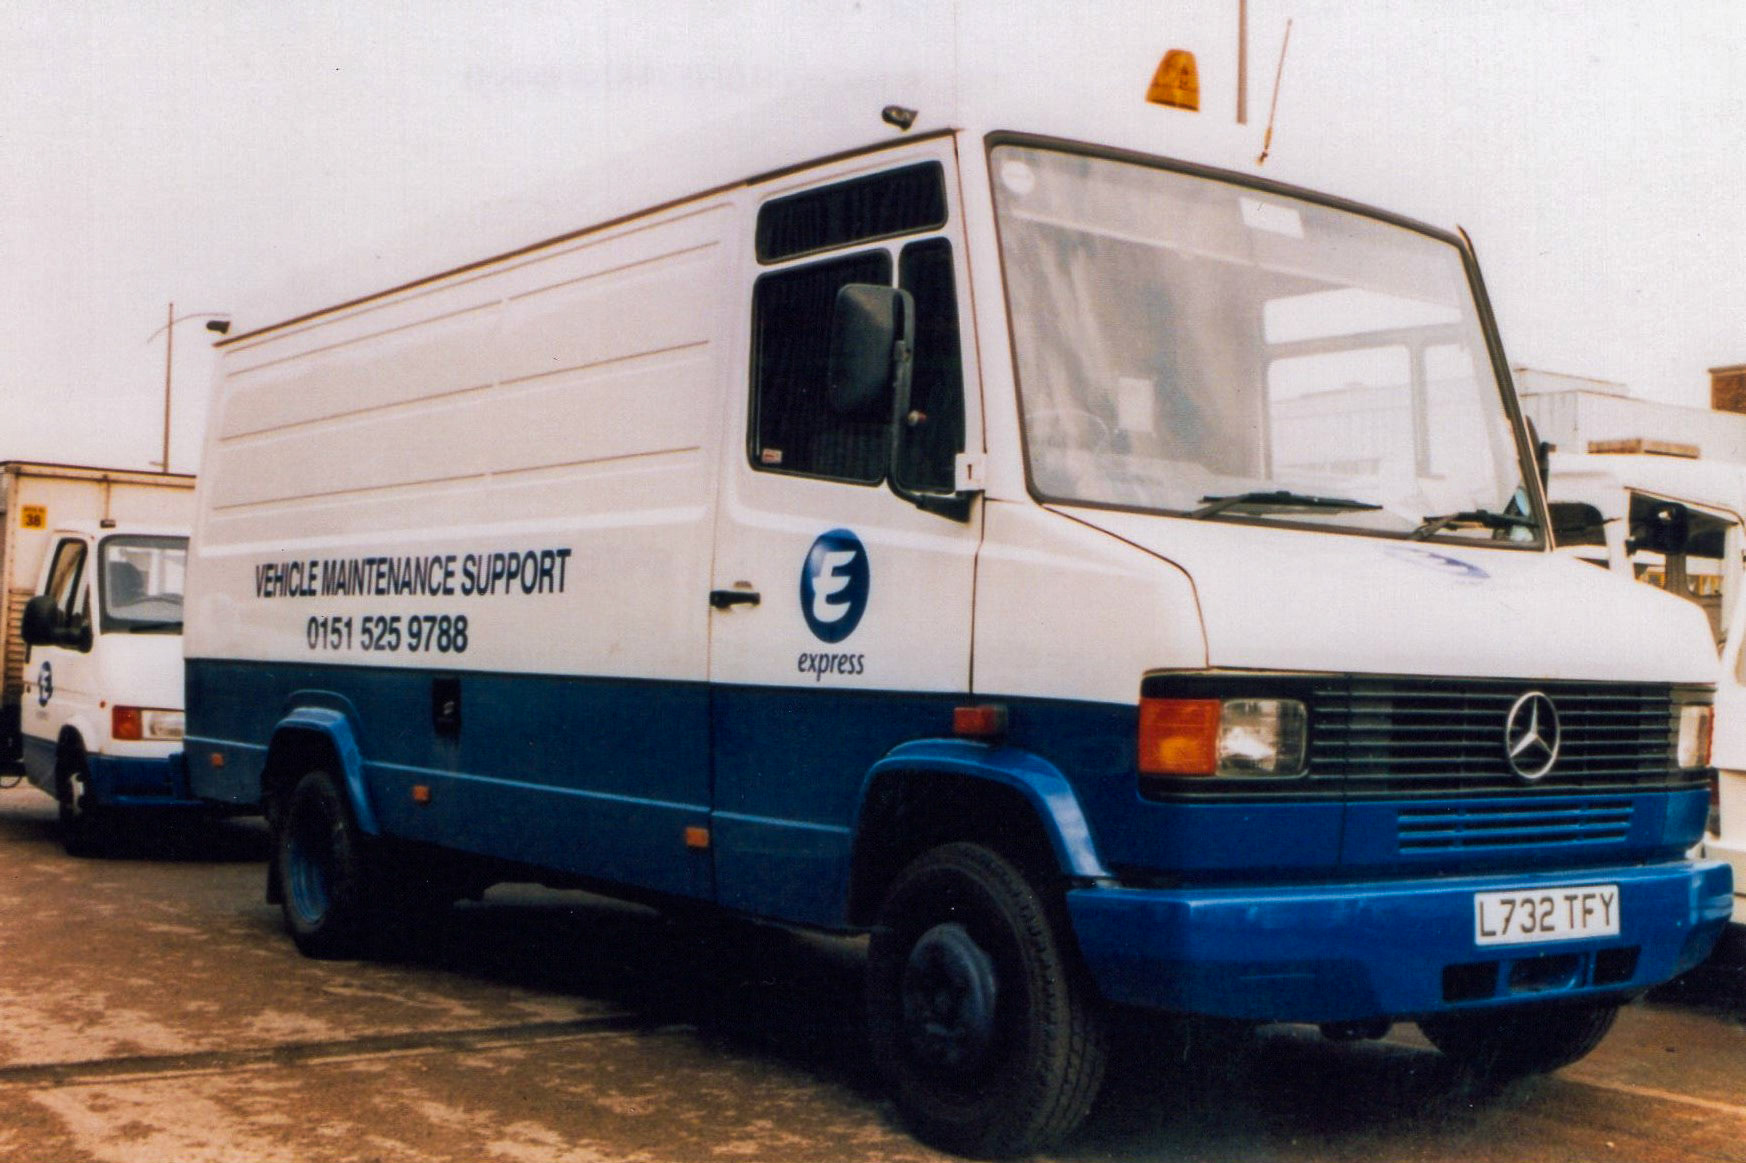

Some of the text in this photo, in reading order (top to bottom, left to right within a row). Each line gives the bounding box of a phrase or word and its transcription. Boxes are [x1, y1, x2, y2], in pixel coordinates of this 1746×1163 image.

[255, 548, 572, 598] VEHICLE MAINTENANCE SUPPORT
[306, 614, 468, 653] 0151 525 9788
[797, 652, 865, 682] express
[1479, 892, 1614, 937] L732 TFY
